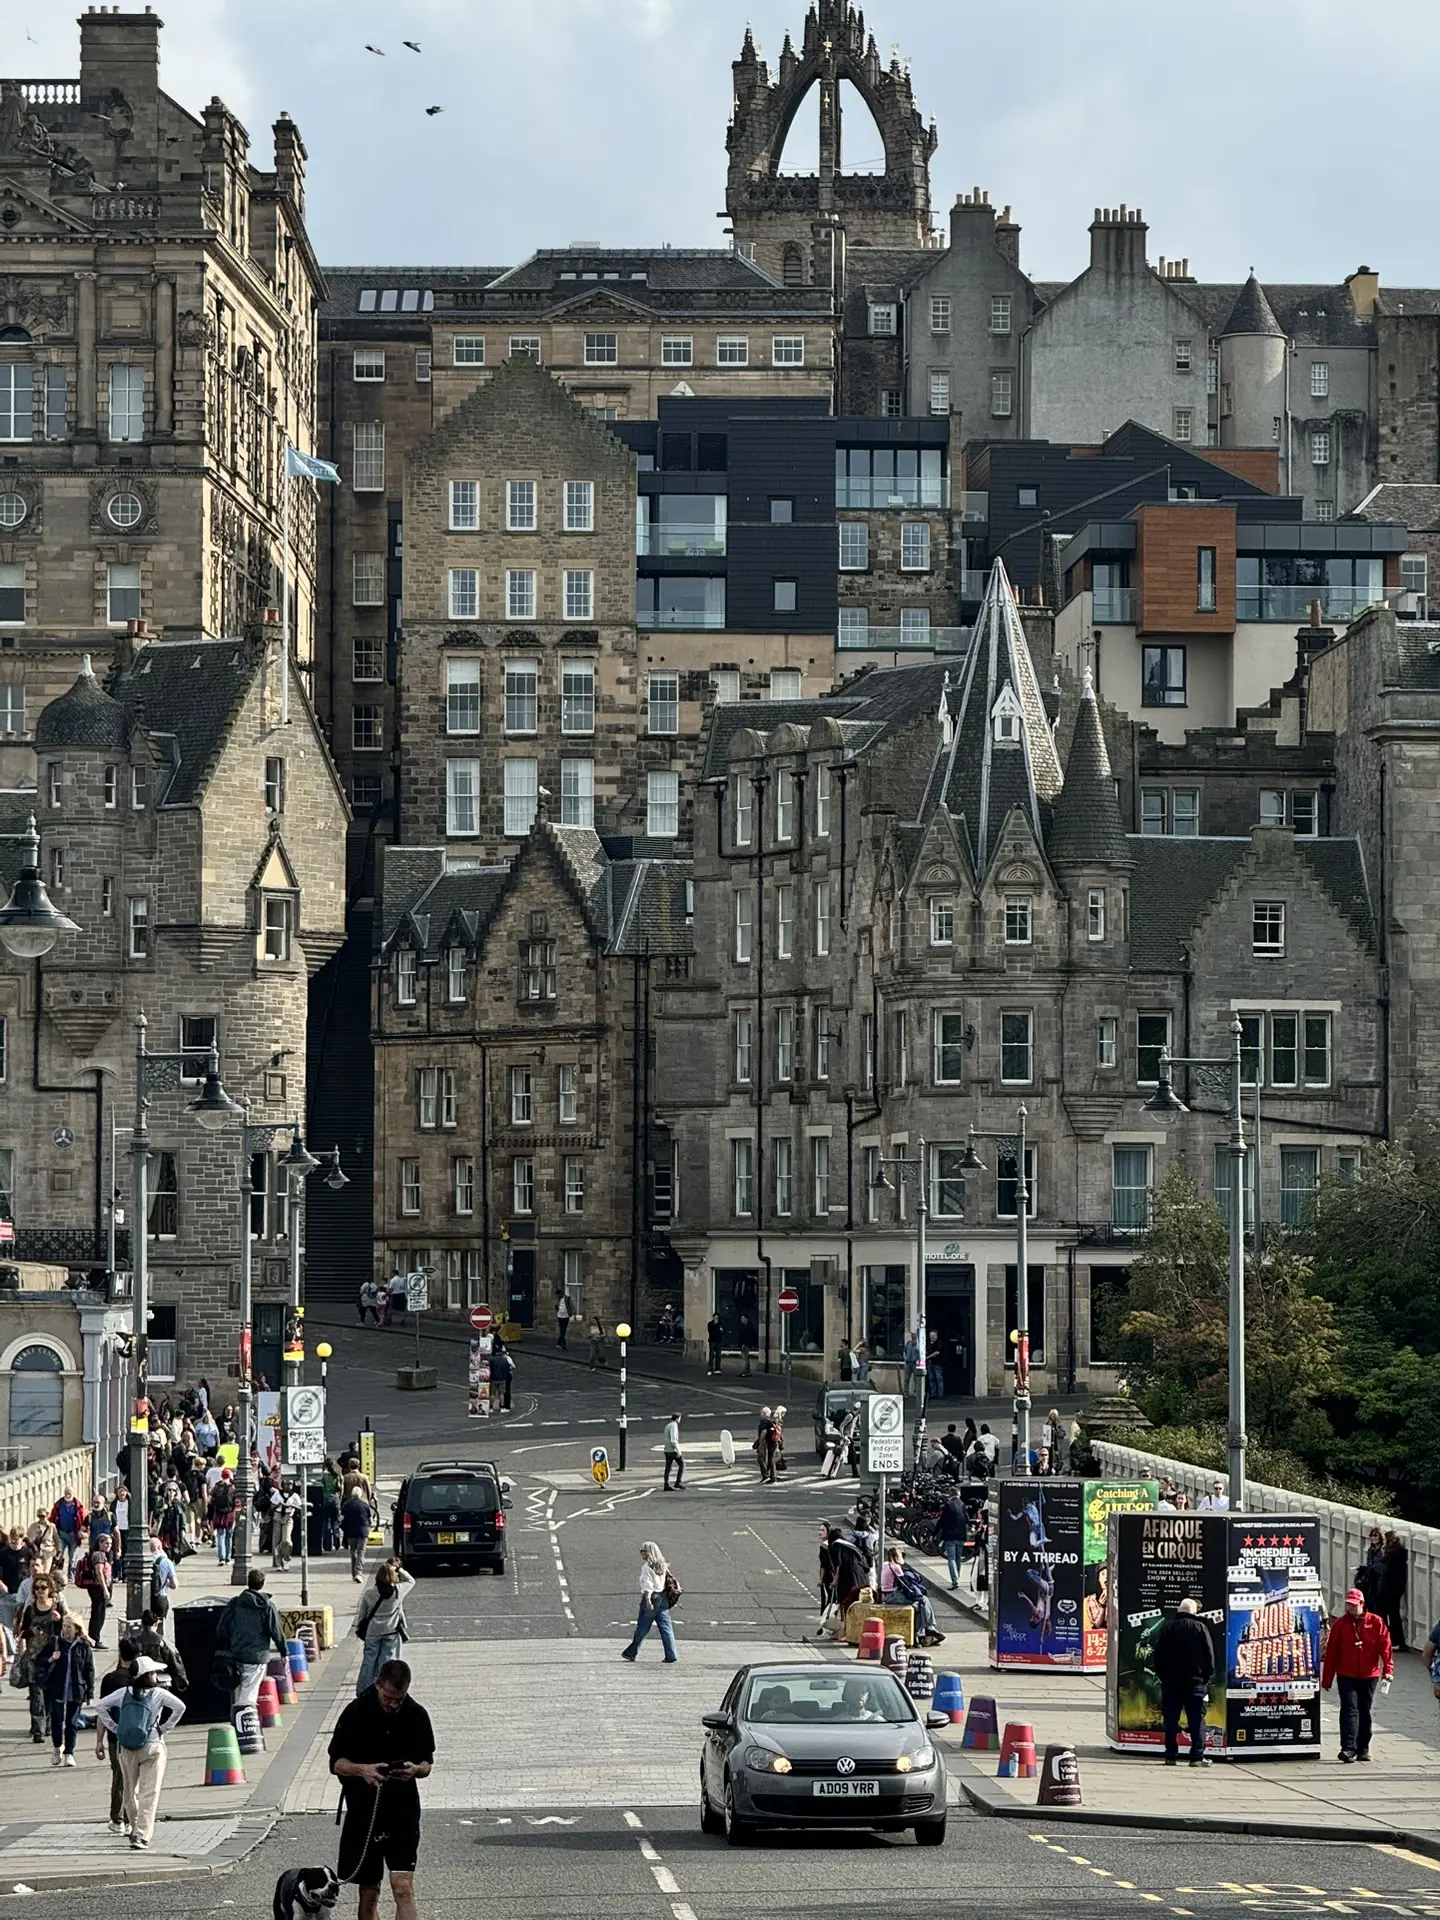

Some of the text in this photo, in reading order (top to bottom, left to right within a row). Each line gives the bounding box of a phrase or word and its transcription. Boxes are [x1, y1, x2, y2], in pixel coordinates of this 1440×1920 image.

[872, 1459, 899, 1468] ENDS
[1096, 1487, 1149, 1501] Catching A
[1143, 1518, 1203, 1542] AFRIQUE
[1004, 1551, 1078, 1564] BY A THREAD
[1142, 1541, 1203, 1563] EN CIRQUE
[1238, 1557, 1273, 1567] DEFIES
[1249, 1599, 1294, 1640] SHOW
[908, 1681, 934, 1689] Edinburg
[1061, 1774, 1076, 1782] Levy
[819, 1783, 874, 1794] AD09 YRR
